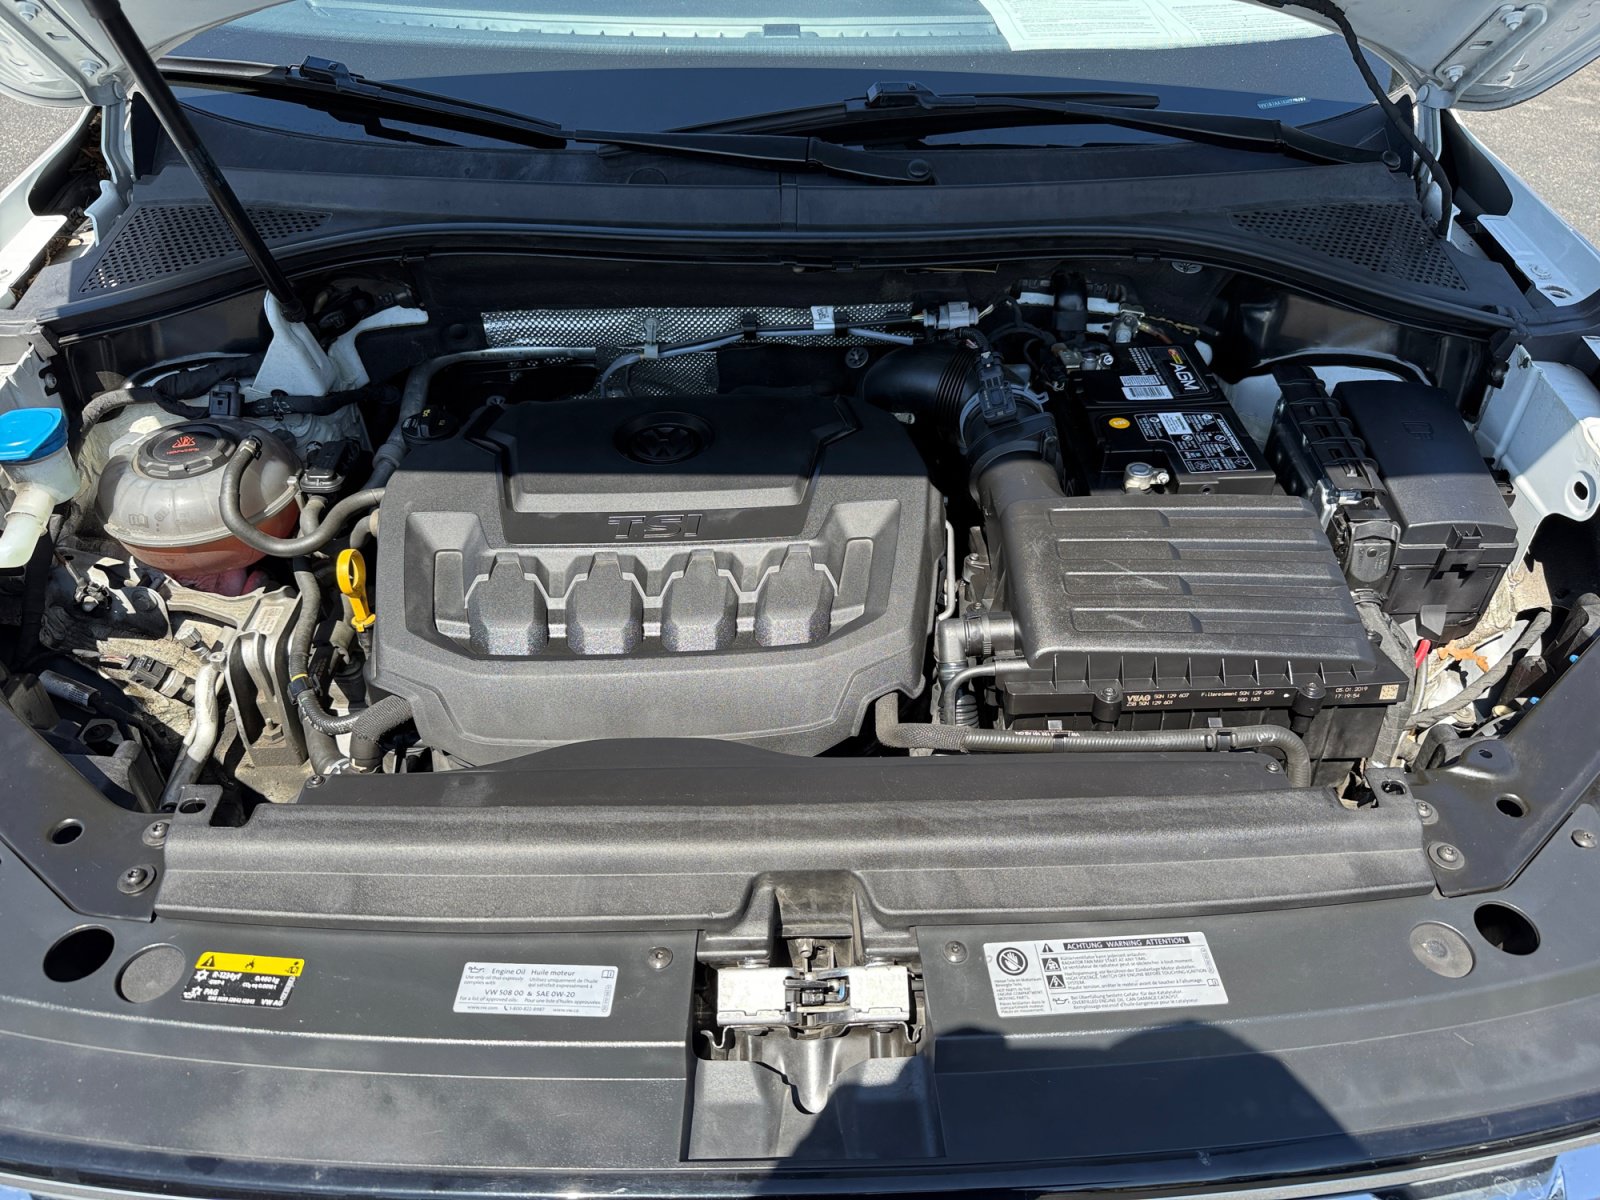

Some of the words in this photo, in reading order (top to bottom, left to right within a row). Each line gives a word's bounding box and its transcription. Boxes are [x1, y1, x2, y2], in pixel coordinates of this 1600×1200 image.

[1170, 362, 1200, 390] AGM
[608, 513, 703, 539] TSI
[1067, 941, 1103, 950] ACHTUNG
[1106, 939, 1142, 948] WARNING
[1146, 937, 1185, 946] ATTENTION
[492, 968, 515, 976] Engine
[203, 988, 220, 996] PAG
[260, 998, 273, 1006] VW
[272, 998, 284, 1007] AG
